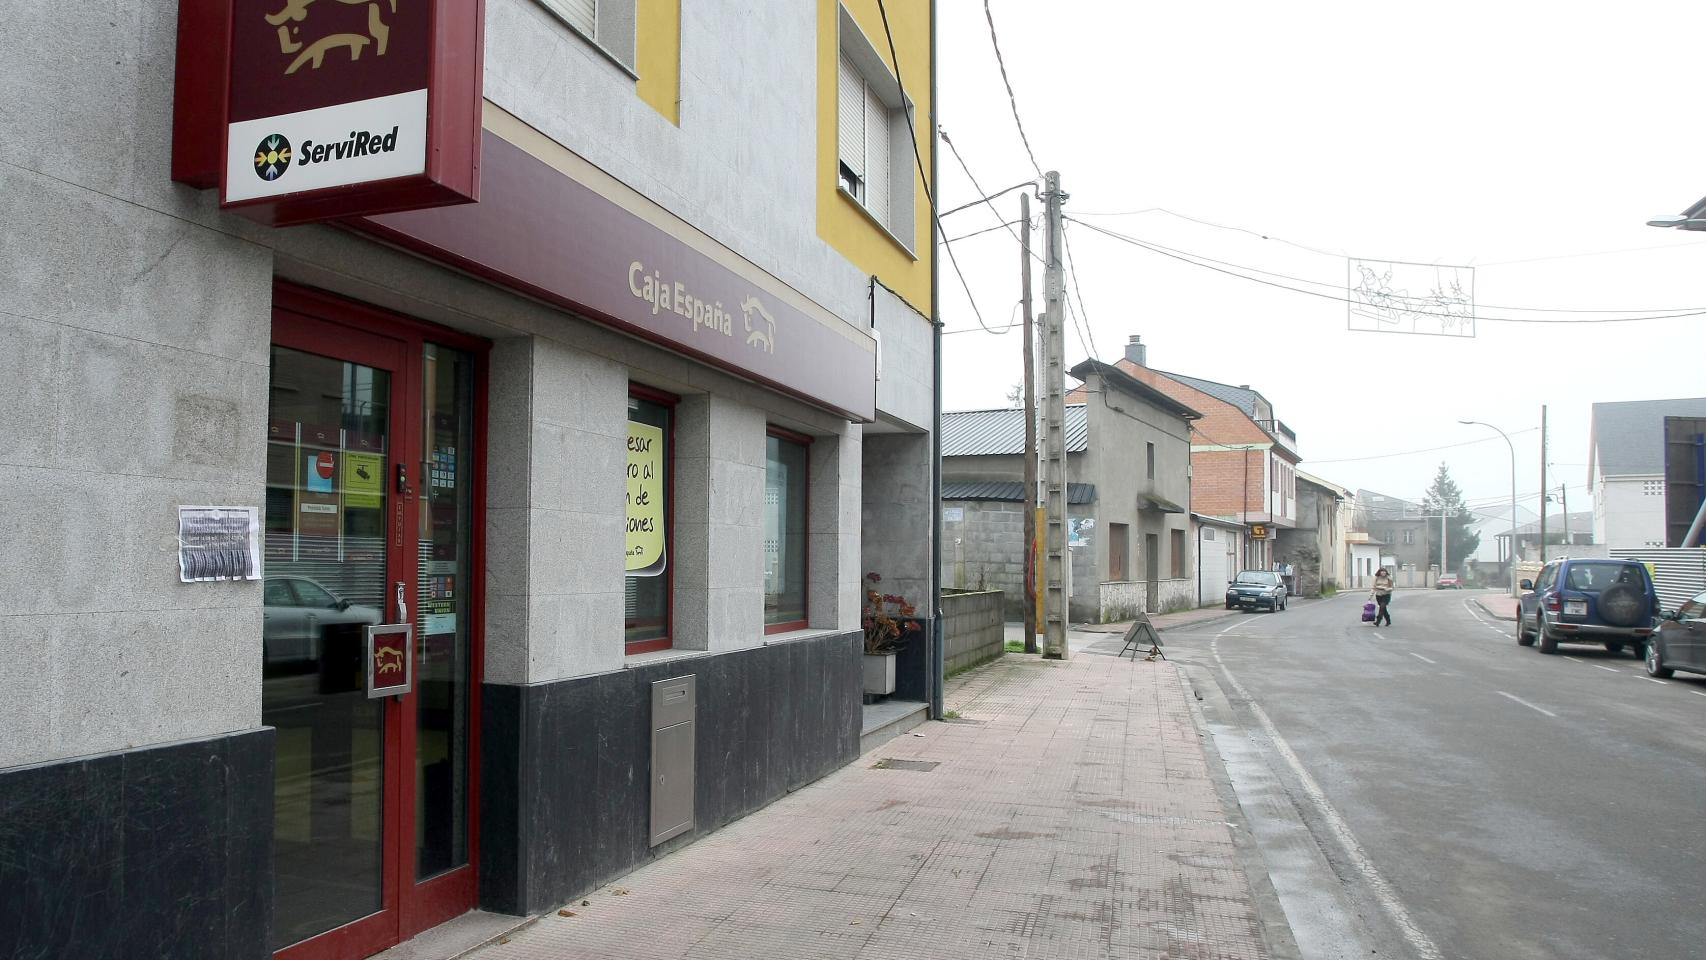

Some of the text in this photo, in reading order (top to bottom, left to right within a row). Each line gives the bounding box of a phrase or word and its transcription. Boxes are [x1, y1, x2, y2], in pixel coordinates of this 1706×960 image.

[298, 126, 398, 166] ServiRed
[628, 261, 732, 336] Caja España
[627, 435, 652, 452] esar
[627, 460, 654, 479] ro al
[636, 484, 650, 505] de
[626, 516, 654, 532] iones
